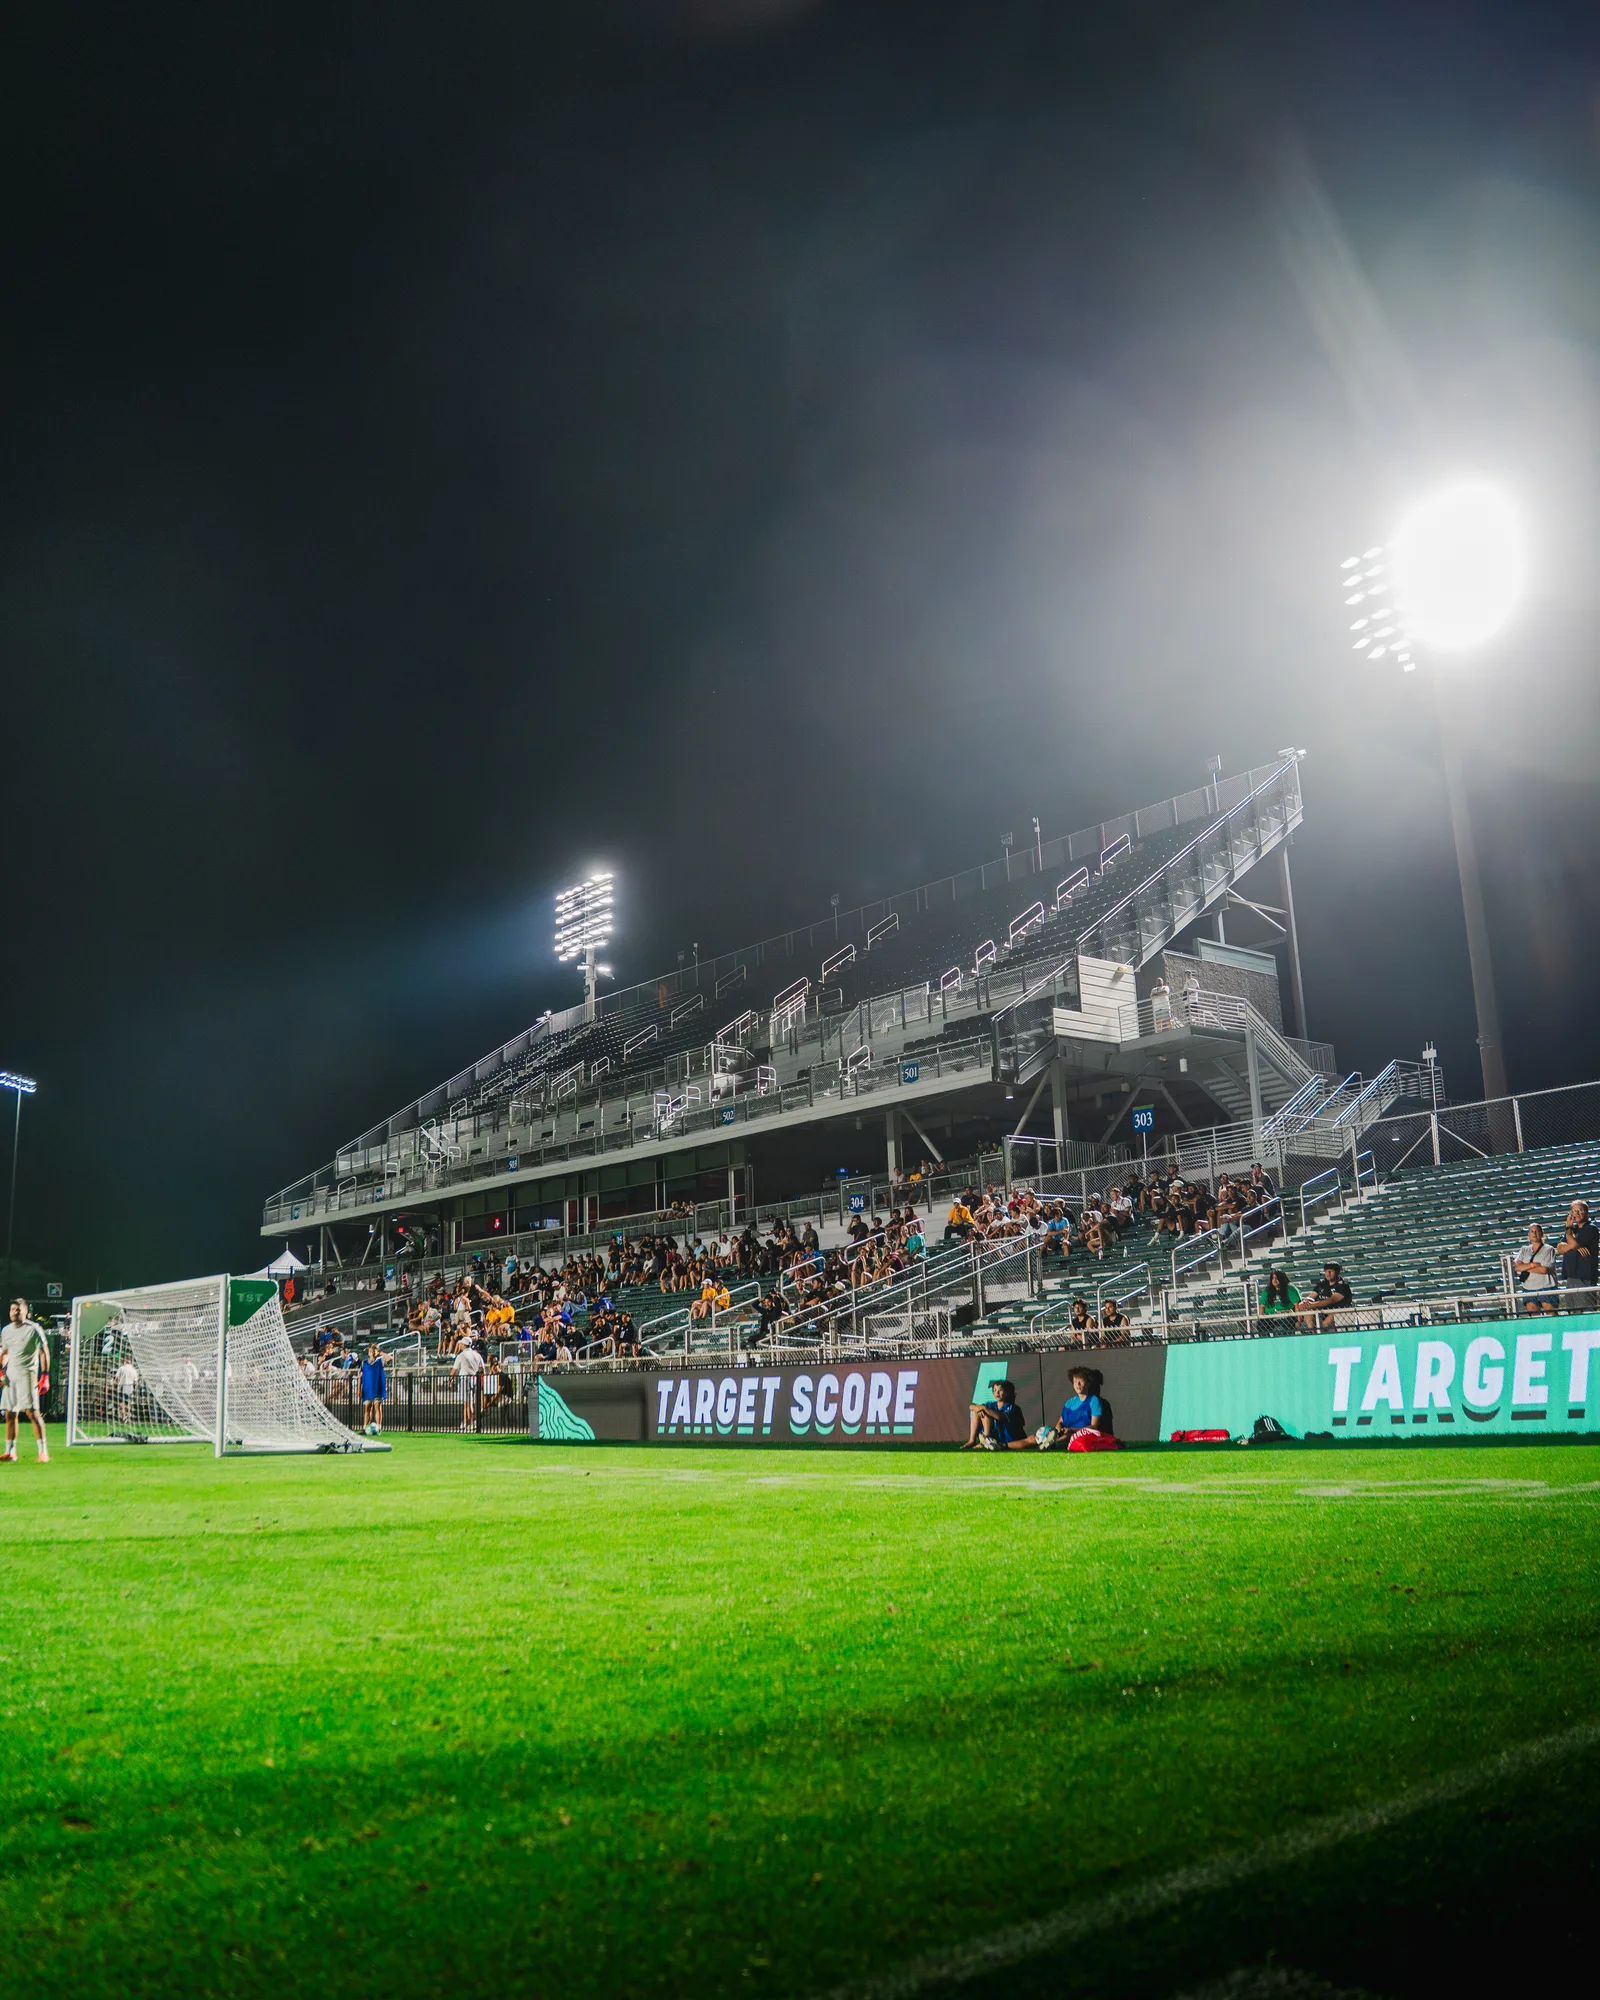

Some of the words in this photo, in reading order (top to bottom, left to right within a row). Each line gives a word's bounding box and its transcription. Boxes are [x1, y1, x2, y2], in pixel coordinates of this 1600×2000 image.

[904, 1066, 918, 1081] 501
[722, 1110, 734, 1122] 502
[1134, 1111, 1153, 1129] 303
[850, 1195, 864, 1209] 304
[101, 1334, 115, 1353] 2
[1328, 1329, 1600, 1412] TARGET
[657, 1376, 781, 1425] TARGET
[789, 1370, 919, 1425] SCORE
